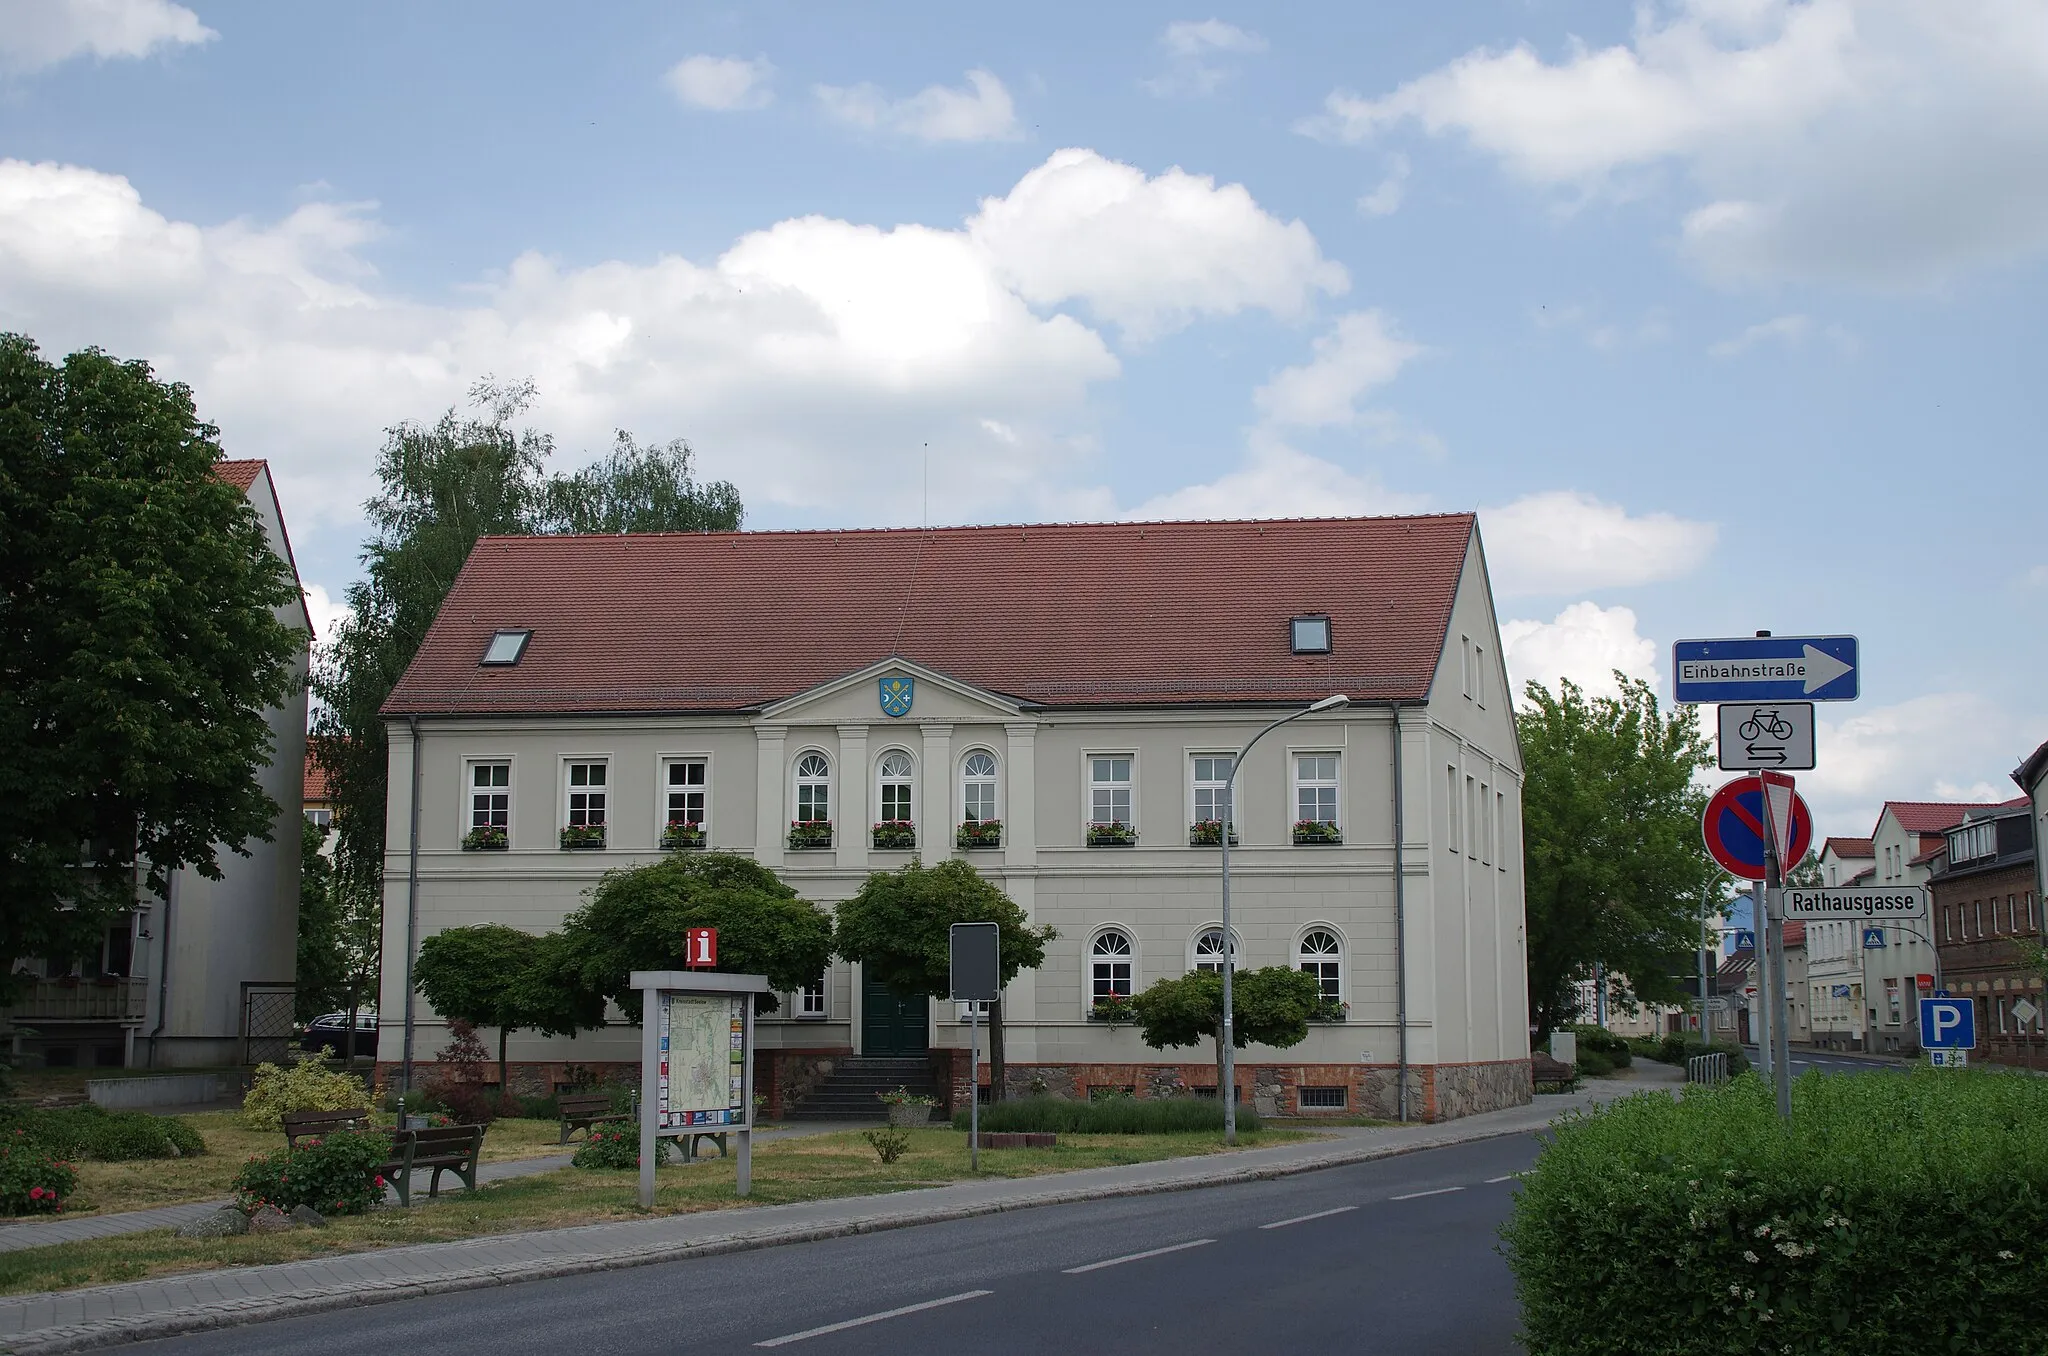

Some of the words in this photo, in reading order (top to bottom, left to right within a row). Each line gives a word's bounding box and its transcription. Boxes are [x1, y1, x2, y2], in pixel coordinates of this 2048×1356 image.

[1683, 663, 1806, 678] Einbahnstraße
[1792, 892, 1914, 916] Rathausgasse
[697, 930, 712, 962] i
[1932, 1005, 1961, 1042] P
